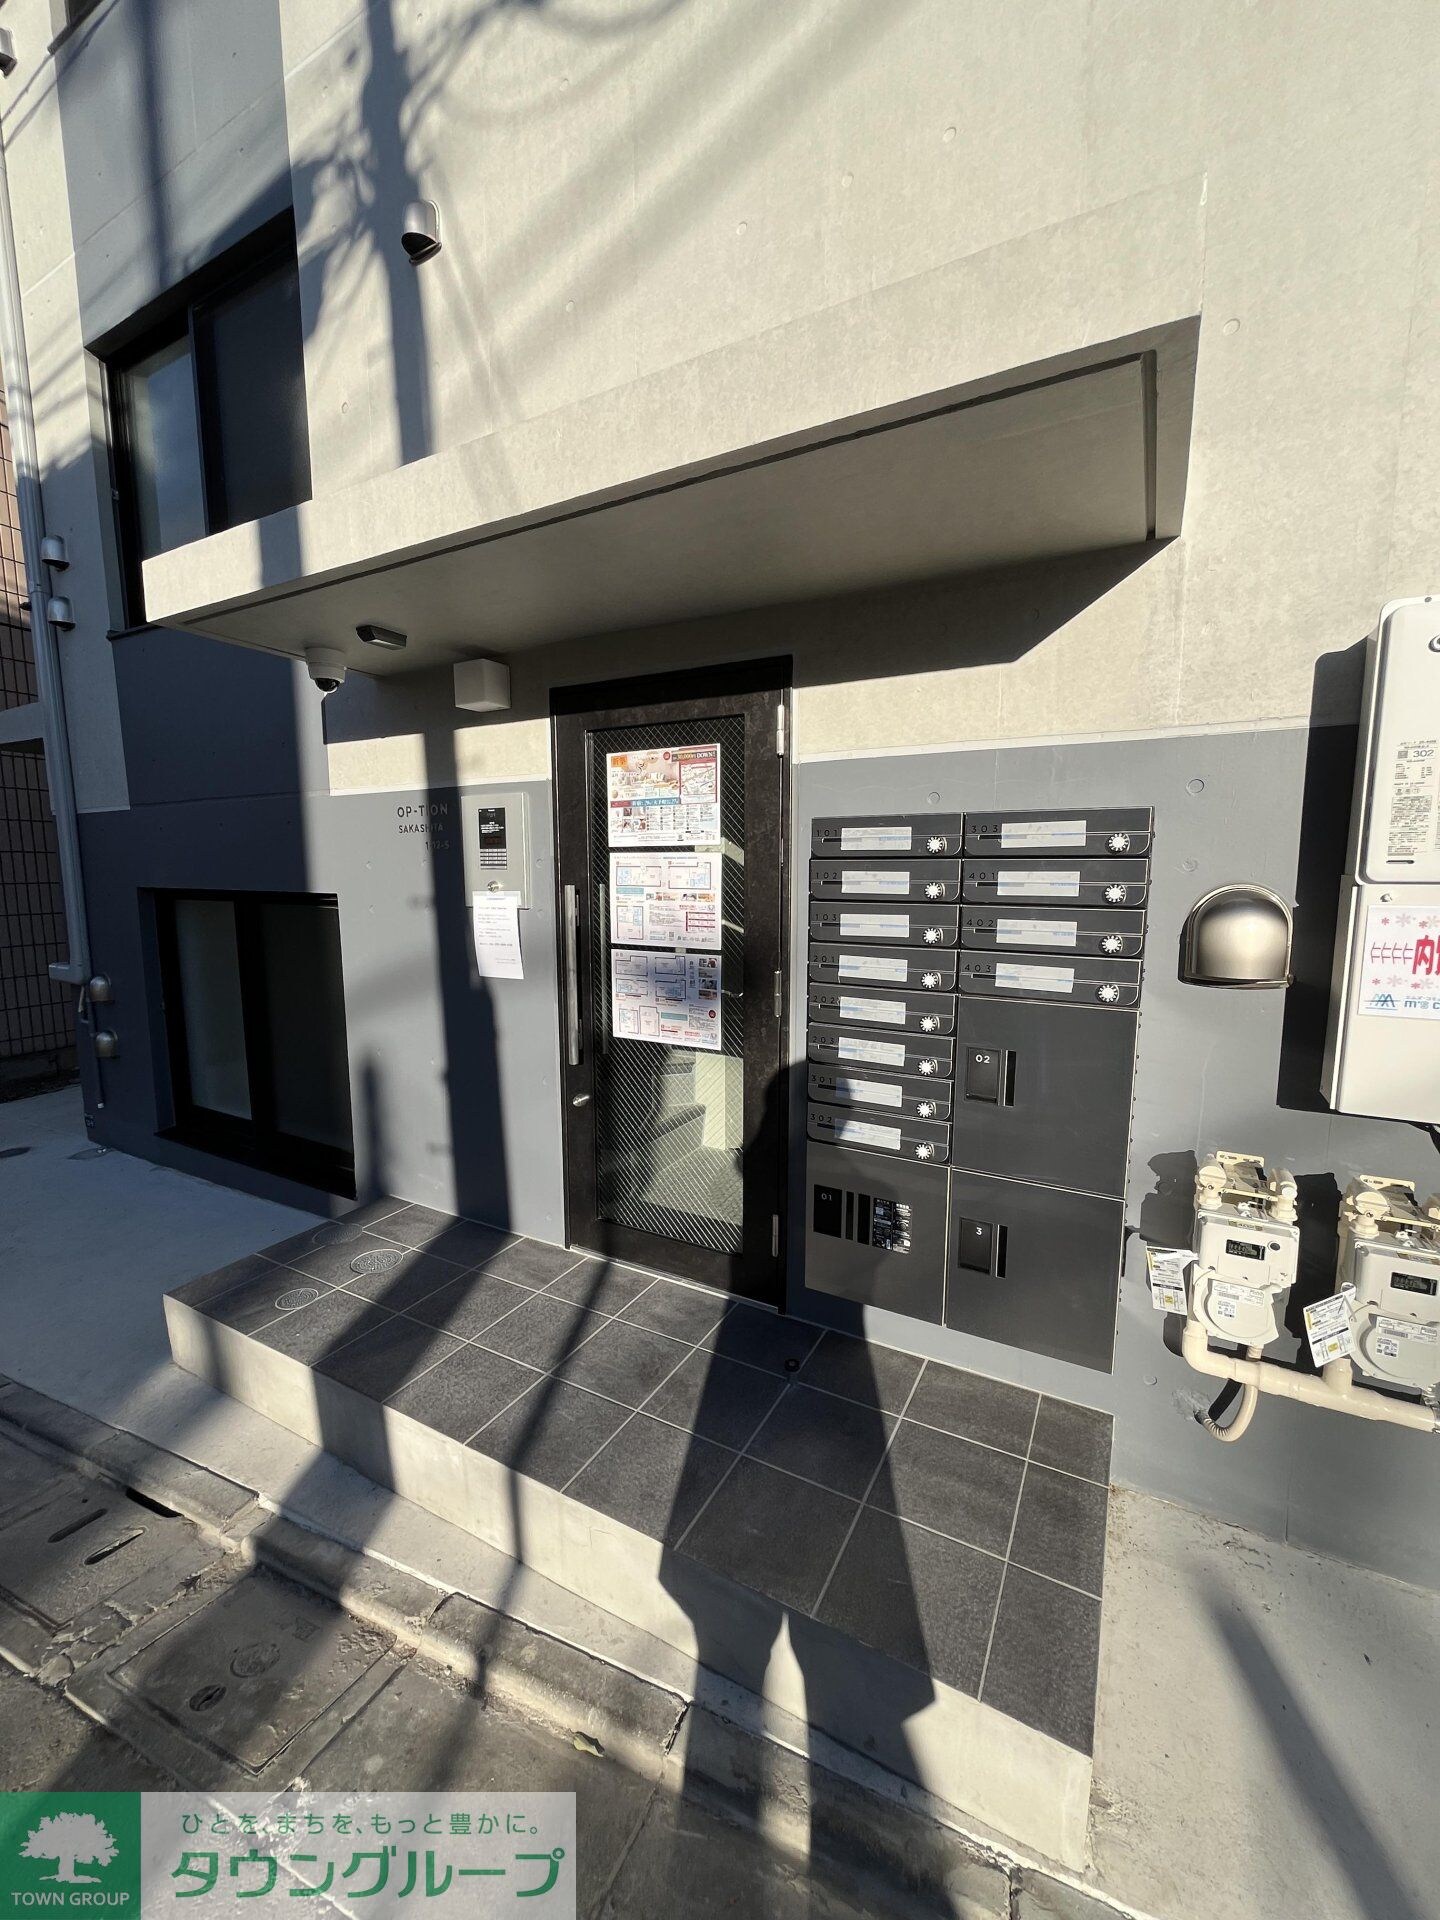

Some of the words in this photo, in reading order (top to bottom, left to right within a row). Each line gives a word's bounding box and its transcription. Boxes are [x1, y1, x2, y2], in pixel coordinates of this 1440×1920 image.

[1412, 749, 1435, 758] 302
[396, 803, 448, 818] OP-TION
[398, 823, 444, 834] SAKASHITA
[971, 825, 999, 833] 303
[816, 829, 838, 838] 101
[968, 872, 995, 880] 401
[815, 913, 837, 921] 103
[966, 919, 994, 927] 402
[813, 955, 835, 963] 201
[964, 964, 992, 973] 403
[813, 995, 836, 1004] 202
[812, 1036, 835, 1045] 203
[975, 1054, 991, 1064] 02
[811, 1074, 833, 1084] 301
[810, 1113, 833, 1123] 302
[820, 1192, 833, 1201] 01
